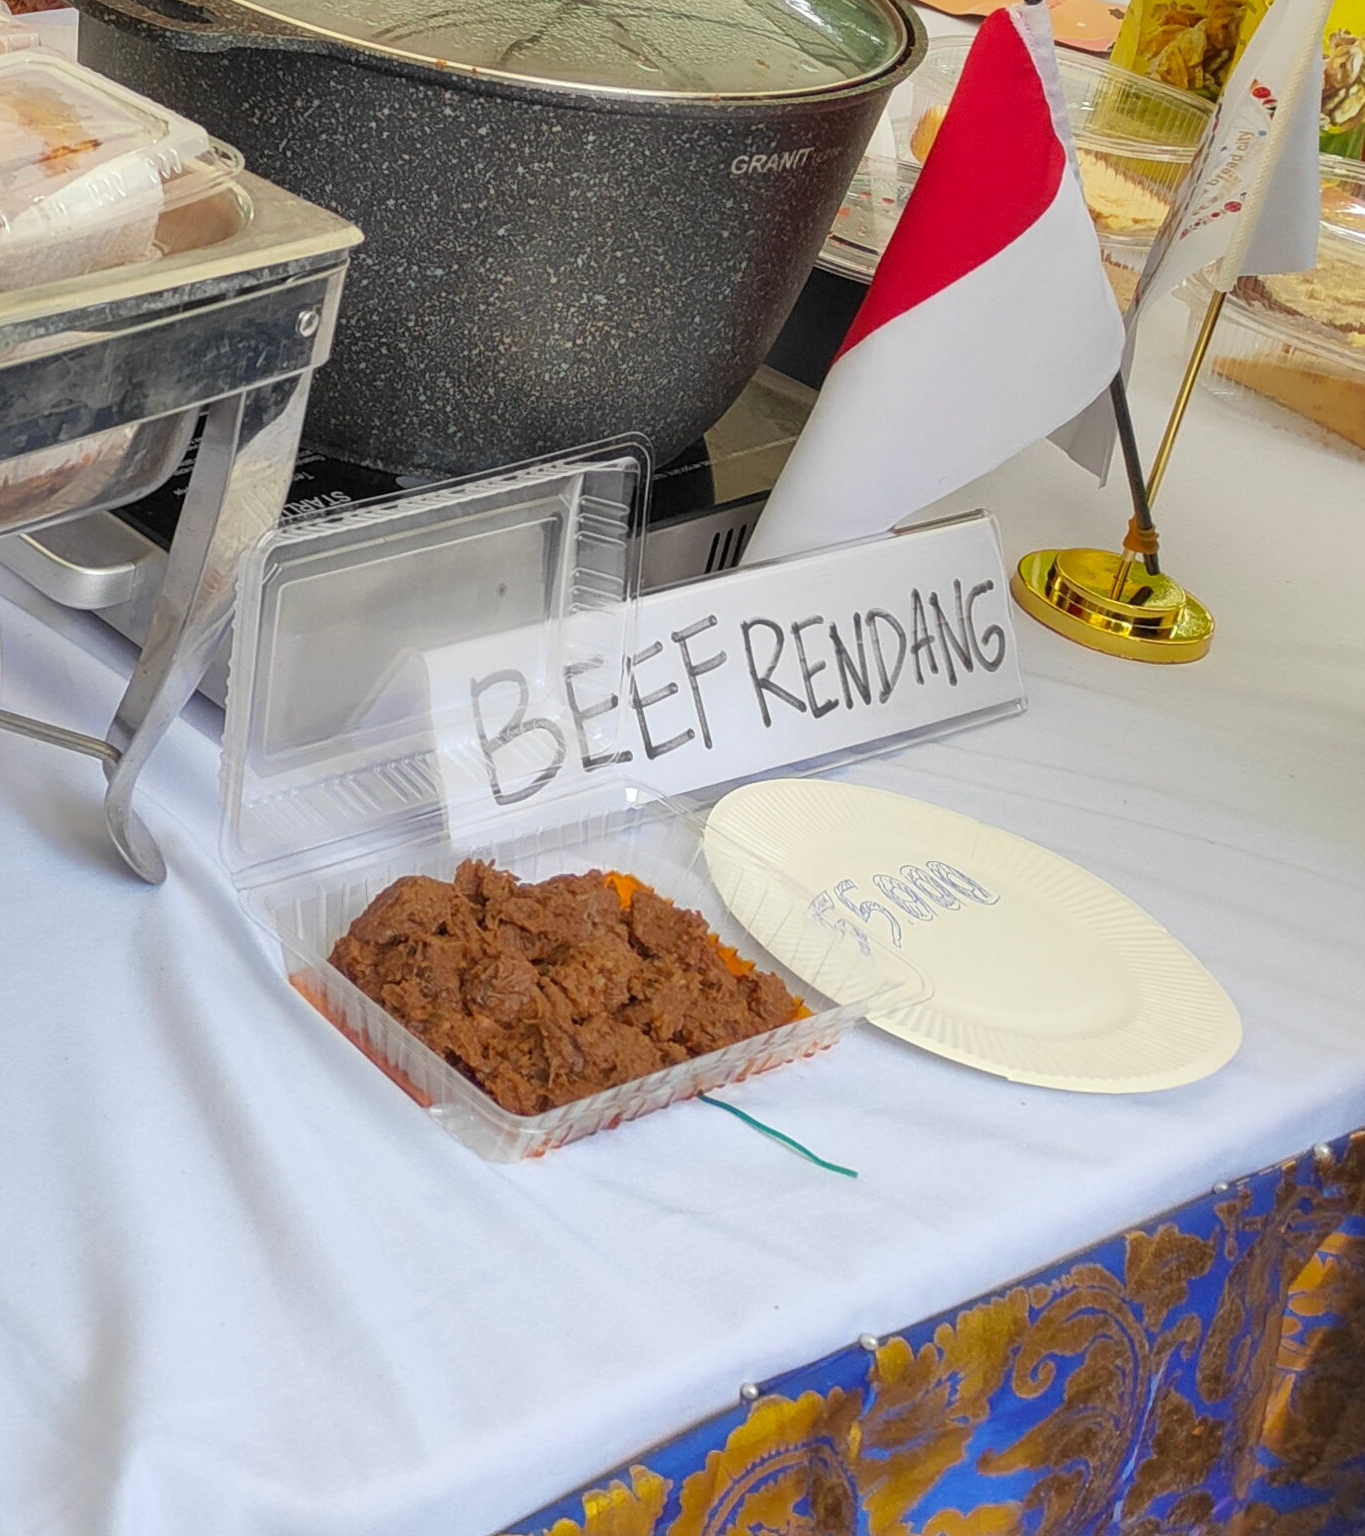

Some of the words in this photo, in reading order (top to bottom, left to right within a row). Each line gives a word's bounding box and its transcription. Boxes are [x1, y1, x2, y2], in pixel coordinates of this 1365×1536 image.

[730, 146, 815, 176] GRANIT
[471, 614, 728, 806] BEEF
[740, 578, 1006, 728] RENDANG
